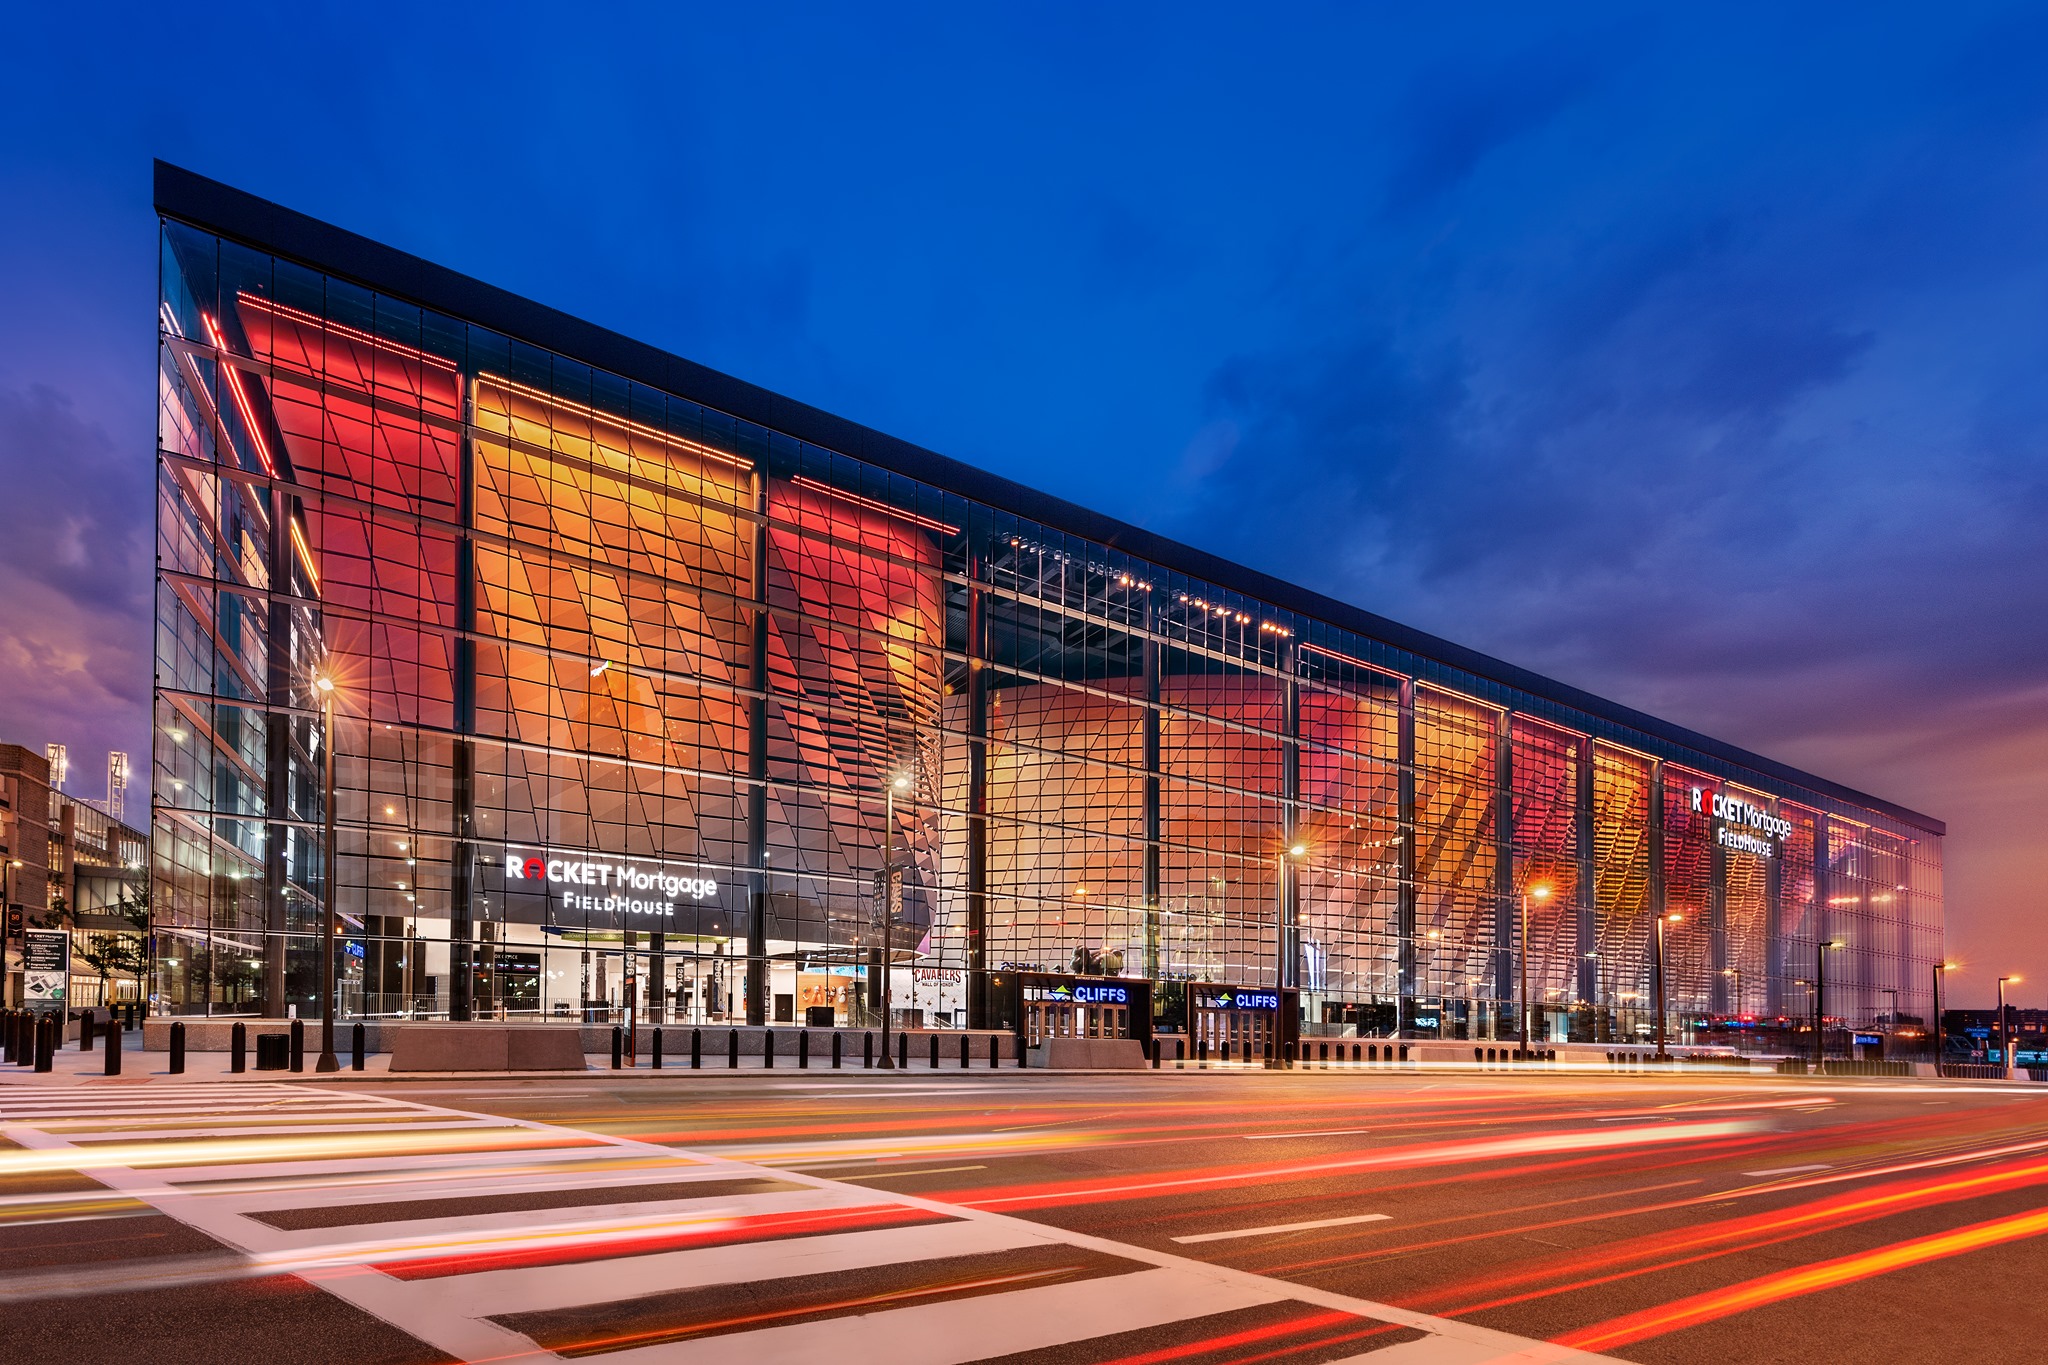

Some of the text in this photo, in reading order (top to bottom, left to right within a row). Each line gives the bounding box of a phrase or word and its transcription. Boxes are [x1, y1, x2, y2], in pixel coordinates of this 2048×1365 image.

[1692, 787, 1792, 840] ROCKET Mortgage
[506, 855, 717, 899] ROCKET Mortgage
[914, 969, 961, 983] CAVALIERS
[1075, 986, 1126, 1002] CLIFFS
[1236, 994, 1277, 1008] CLIFFS
